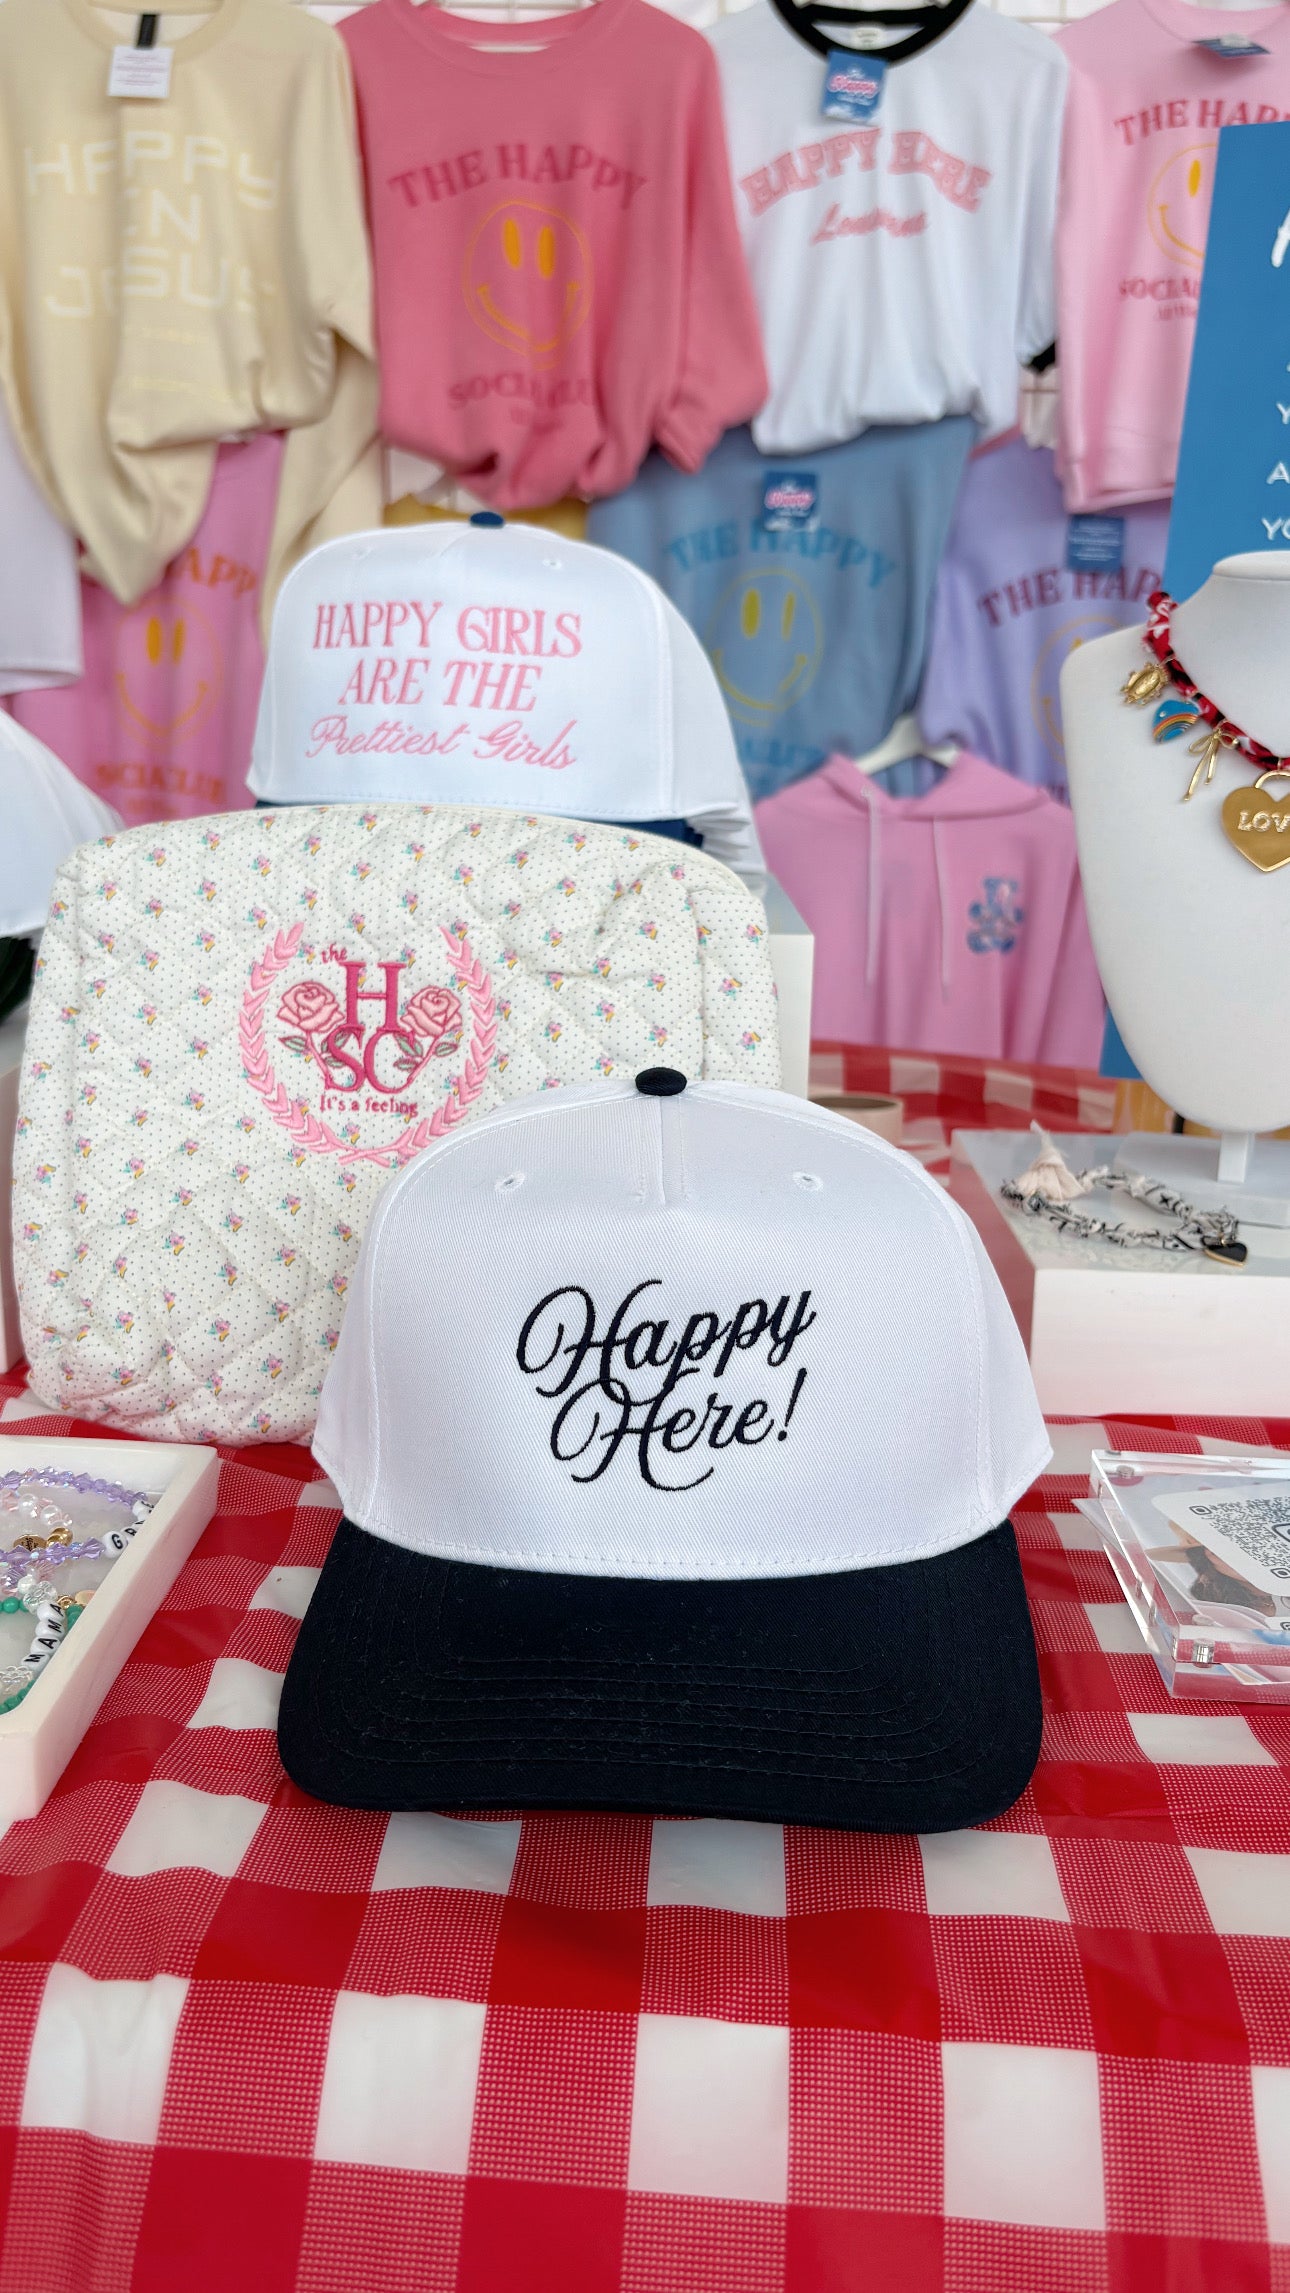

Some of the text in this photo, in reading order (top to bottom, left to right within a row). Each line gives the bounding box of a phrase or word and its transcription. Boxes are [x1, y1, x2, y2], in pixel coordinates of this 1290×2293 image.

[1114, 98, 1290, 146] THE HAP
[387, 143, 648, 211] THE HAPPY
[739, 127, 882, 218] HAPPY
[976, 566, 1060, 627] THE
[312, 601, 583, 658] HAPPY GIRLS
[337, 658, 544, 712] ARE THE
[305, 715, 578, 770] Prettiest Girls
[321, 943, 348, 963] the
[319, 1097, 418, 1117] It's a feeling
[516, 1279, 817, 1406] Happy
[549, 1366, 808, 1492] Here!
[23, 1602, 66, 1664] MAMA
